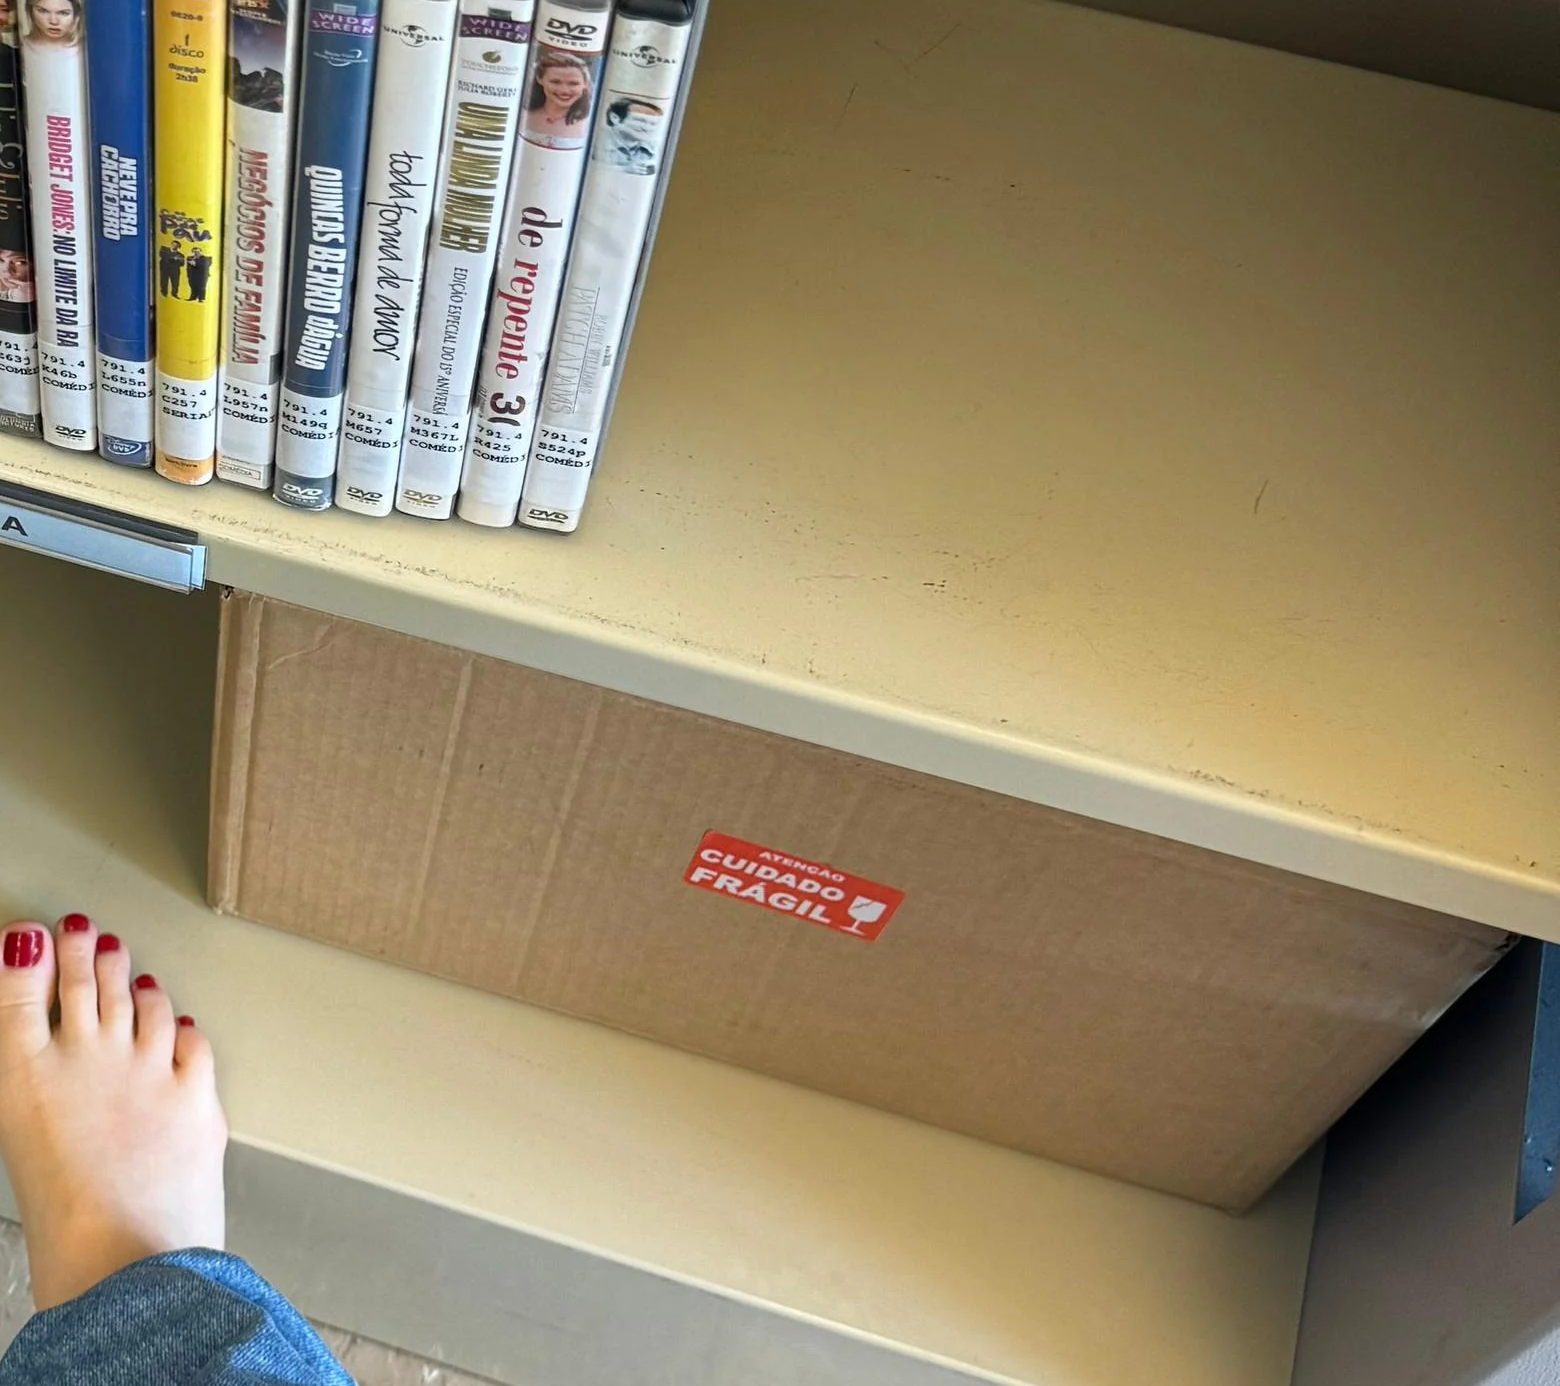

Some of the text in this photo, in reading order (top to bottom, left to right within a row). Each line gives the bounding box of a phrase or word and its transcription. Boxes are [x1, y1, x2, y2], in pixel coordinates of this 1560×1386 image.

[312, 20, 375, 34] SCREEN
[318, 12, 373, 25] WIDE
[470, 17, 522, 31] WIDE
[546, 18, 597, 35] DVD
[461, 26, 528, 41] SCREEN
[169, 42, 204, 59] disco
[455, 102, 510, 141] UMA
[448, 140, 504, 190] LINDA
[100, 144, 121, 241] CACHORRO
[47, 114, 78, 330] BRIDGET JONES: NO LIMITE DA
[439, 188, 495, 254] MULHER
[304, 165, 347, 314] QUINCAS BERRO
[232, 148, 273, 364] NEGÓCIOS DE FAMÍLIA
[367, 151, 427, 361] toda forma de amor
[494, 207, 563, 380] de repente
[444, 267, 468, 347] EDIÇÃO ESPECIAL
[548, 287, 596, 413] PATCH ADAMS
[41, 352, 86, 368] 791.4
[101, 359, 145, 375] 791.4
[162, 383, 207, 397] 791.4
[223, 383, 268, 400] 791.4
[162, 396, 197, 408] C257
[283, 399, 327, 416] 791.4
[348, 408, 392, 425] 791.4
[414, 414, 459, 429] 791.4
[346, 420, 382, 435] M657
[477, 425, 522, 440] 791.4
[475, 436, 511, 452] R425
[541, 430, 588, 445] 791.4
[700, 849, 845, 901] CUIDADO
[690, 867, 831, 923] FRÁGIL
